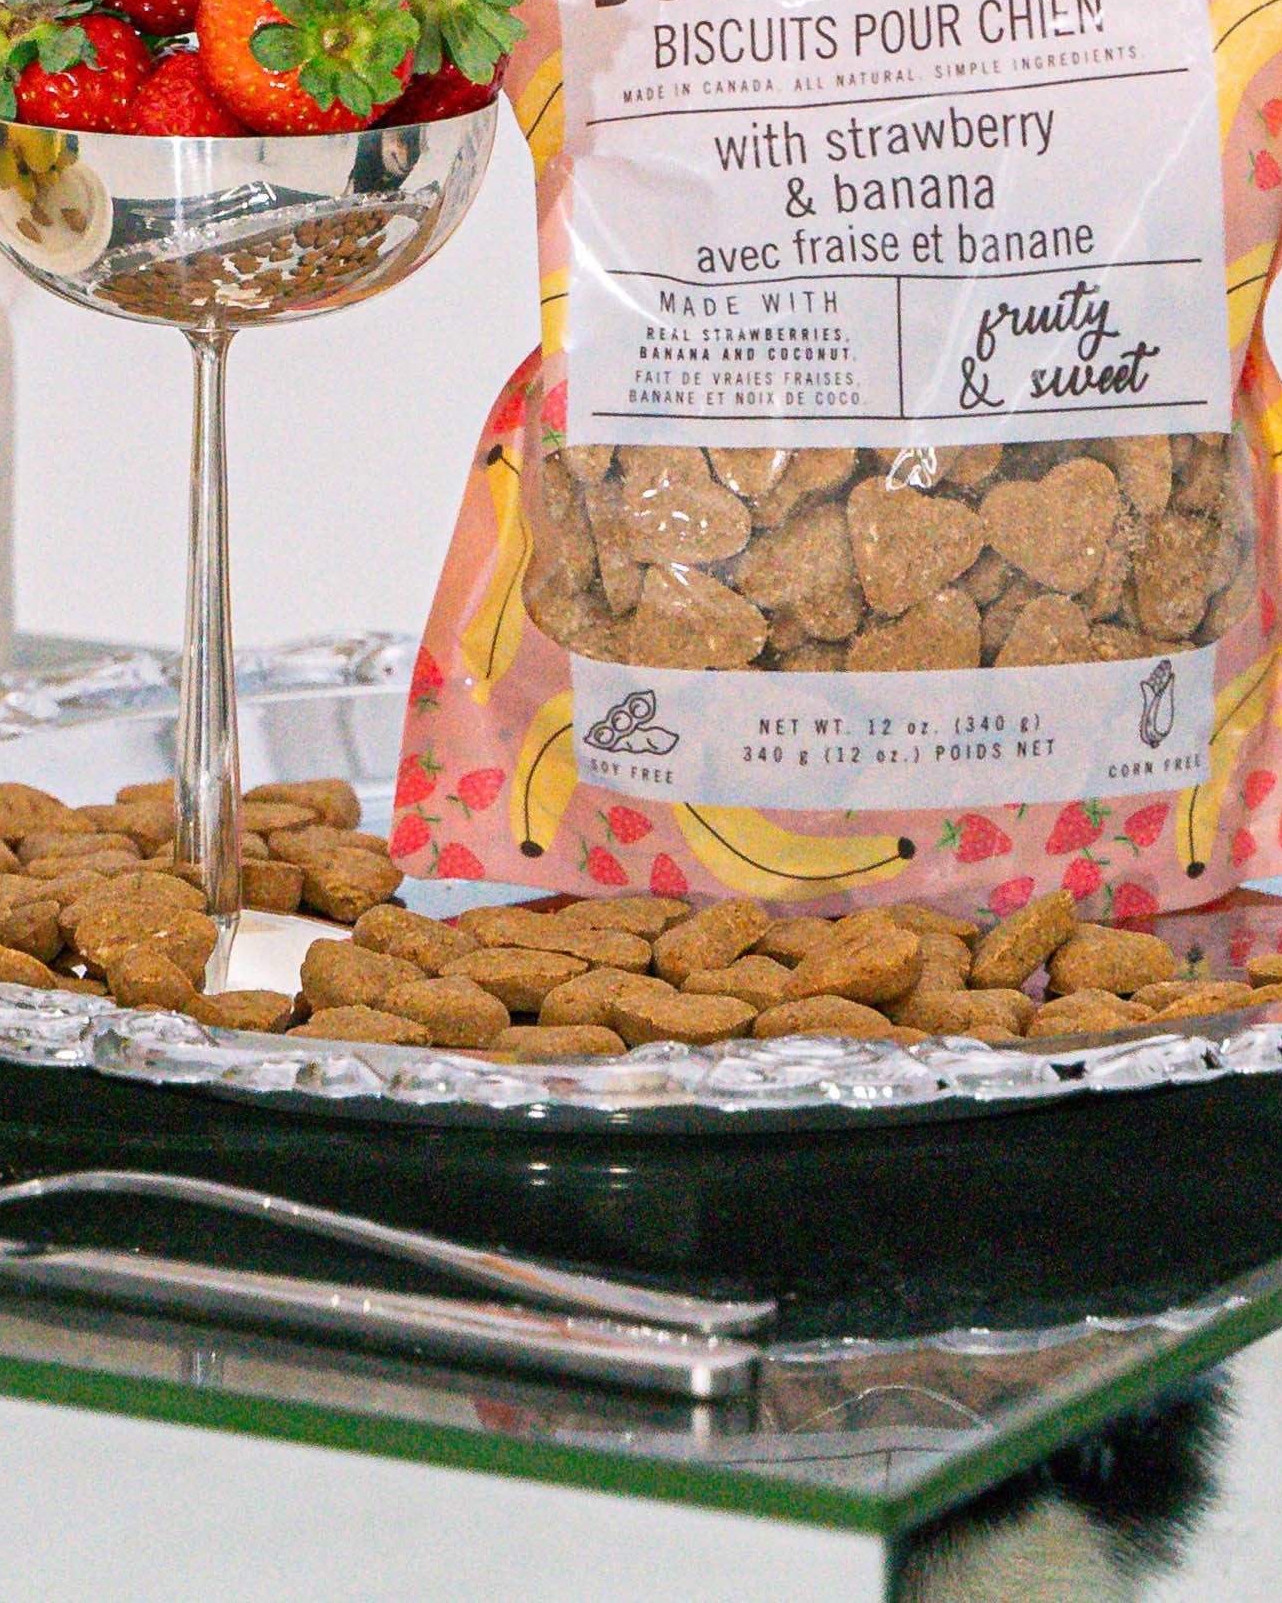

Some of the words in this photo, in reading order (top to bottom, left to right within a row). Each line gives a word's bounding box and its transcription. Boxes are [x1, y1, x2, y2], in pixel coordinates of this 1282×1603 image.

[654, 16, 837, 69] BISCUITS
[854, 3, 961, 57] POUR
[623, 84, 666, 103] MADE
[675, 81, 690, 96] IN
[794, 77, 824, 92] ALL
[935, 58, 1001, 78] SIMPLE
[714, 122, 807, 171] with
[825, 106, 1055, 161] strawberry
[785, 179, 816, 217] &
[836, 173, 995, 213] banana
[696, 241, 781, 273] avec
[792, 227, 899, 267] fraise
[912, 233, 943, 264] et
[959, 224, 1095, 263] banane
[659, 290, 739, 317] MADE
[761, 291, 838, 313] WITH
[646, 327, 690, 341] REAL
[976, 280, 1120, 361] fruity
[639, 346, 709, 362] BANANA
[721, 347, 755, 361] AND
[635, 370, 670, 384] FAIT
[682, 371, 701, 386] DE
[712, 371, 773, 386] VRAIES
[959, 356, 1005, 410] &
[1030, 341, 1160, 398] sweet
[628, 389, 695, 405] BANANE
[706, 390, 724, 405] ET
[735, 390, 775, 405] NOIX
[785, 391, 805, 405] DE
[759, 718, 799, 735] NET
[868, 717, 892, 735] 12
[907, 721, 938, 735] oz.
[955, 714, 1005, 734] (340
[1020, 713, 1040, 734] g)
[743, 746, 783, 763] 340
[799, 750, 808, 766] g
[824, 746, 861, 764] (12
[875, 746, 920, 763] oz.)
[934, 743, 1002, 762] POIDS
[1017, 738, 1055, 757] NET
[590, 758, 621, 776] SOY
[631, 765, 673, 784] FREE
[1109, 761, 1153, 779] CORN
[1164, 754, 1202, 772] FREE
